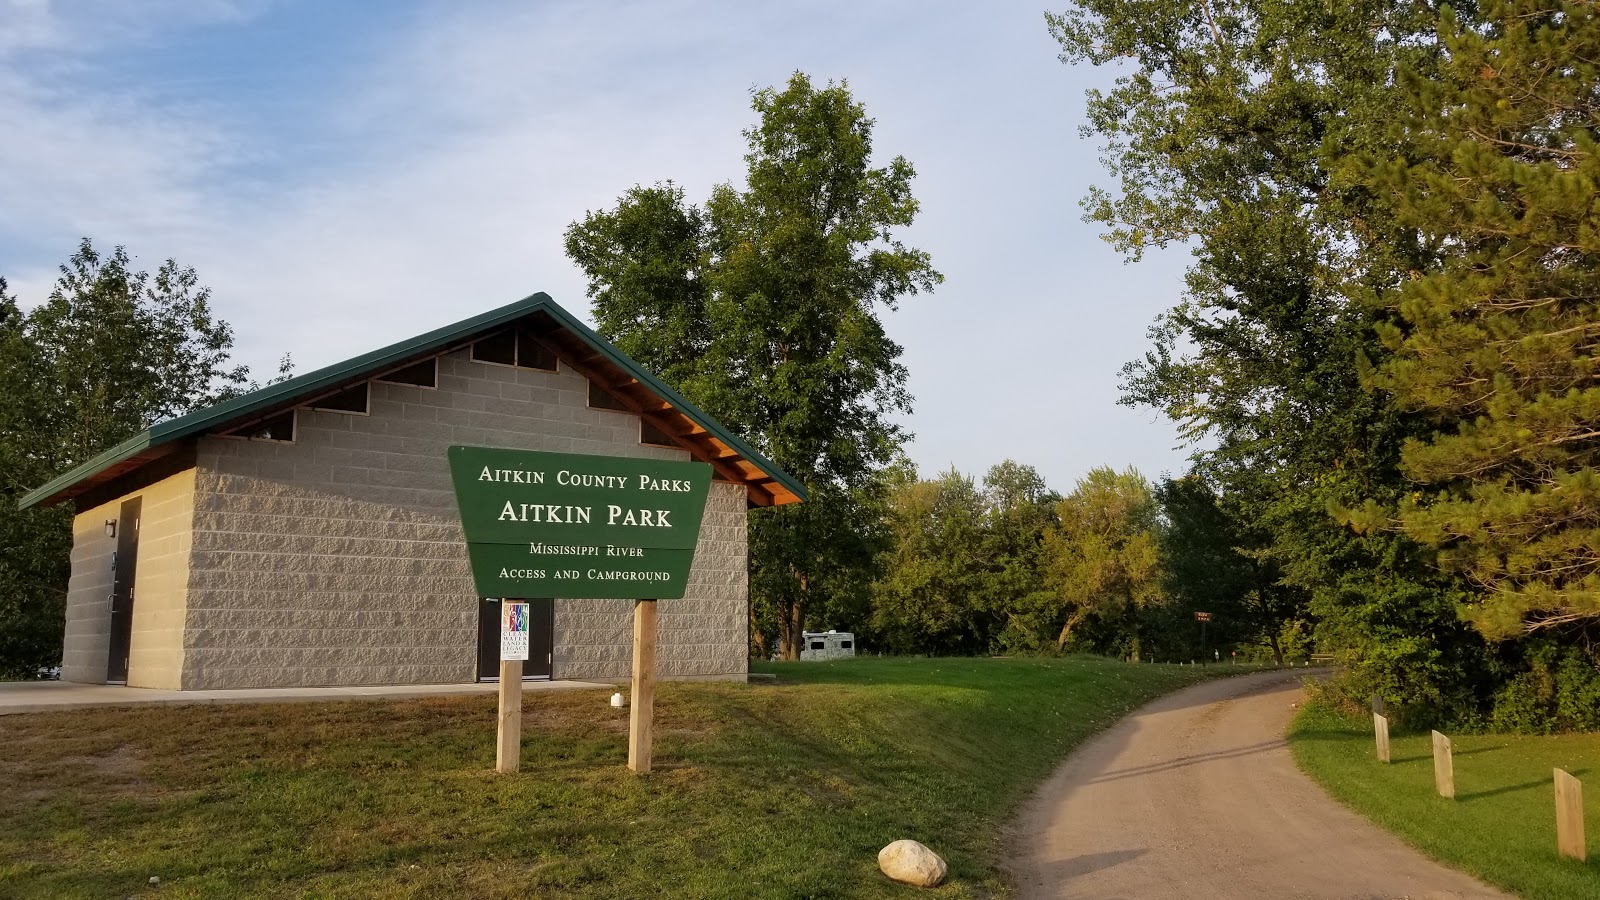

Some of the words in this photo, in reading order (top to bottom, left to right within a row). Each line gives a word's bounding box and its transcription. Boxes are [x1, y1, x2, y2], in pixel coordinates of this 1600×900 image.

[478, 465, 545, 484] AITKIN
[557, 470, 628, 489] COUNTY
[639, 474, 691, 492] PARKS
[498, 500, 592, 524] AITKIN
[607, 505, 673, 528] PARK
[530, 542, 599, 556] MISSISSIPPI
[607, 545, 644, 557] RIVER
[499, 567, 546, 580] ACCESS
[554, 569, 580, 580] AND
[587, 569, 671, 582] CAMPGROUND
